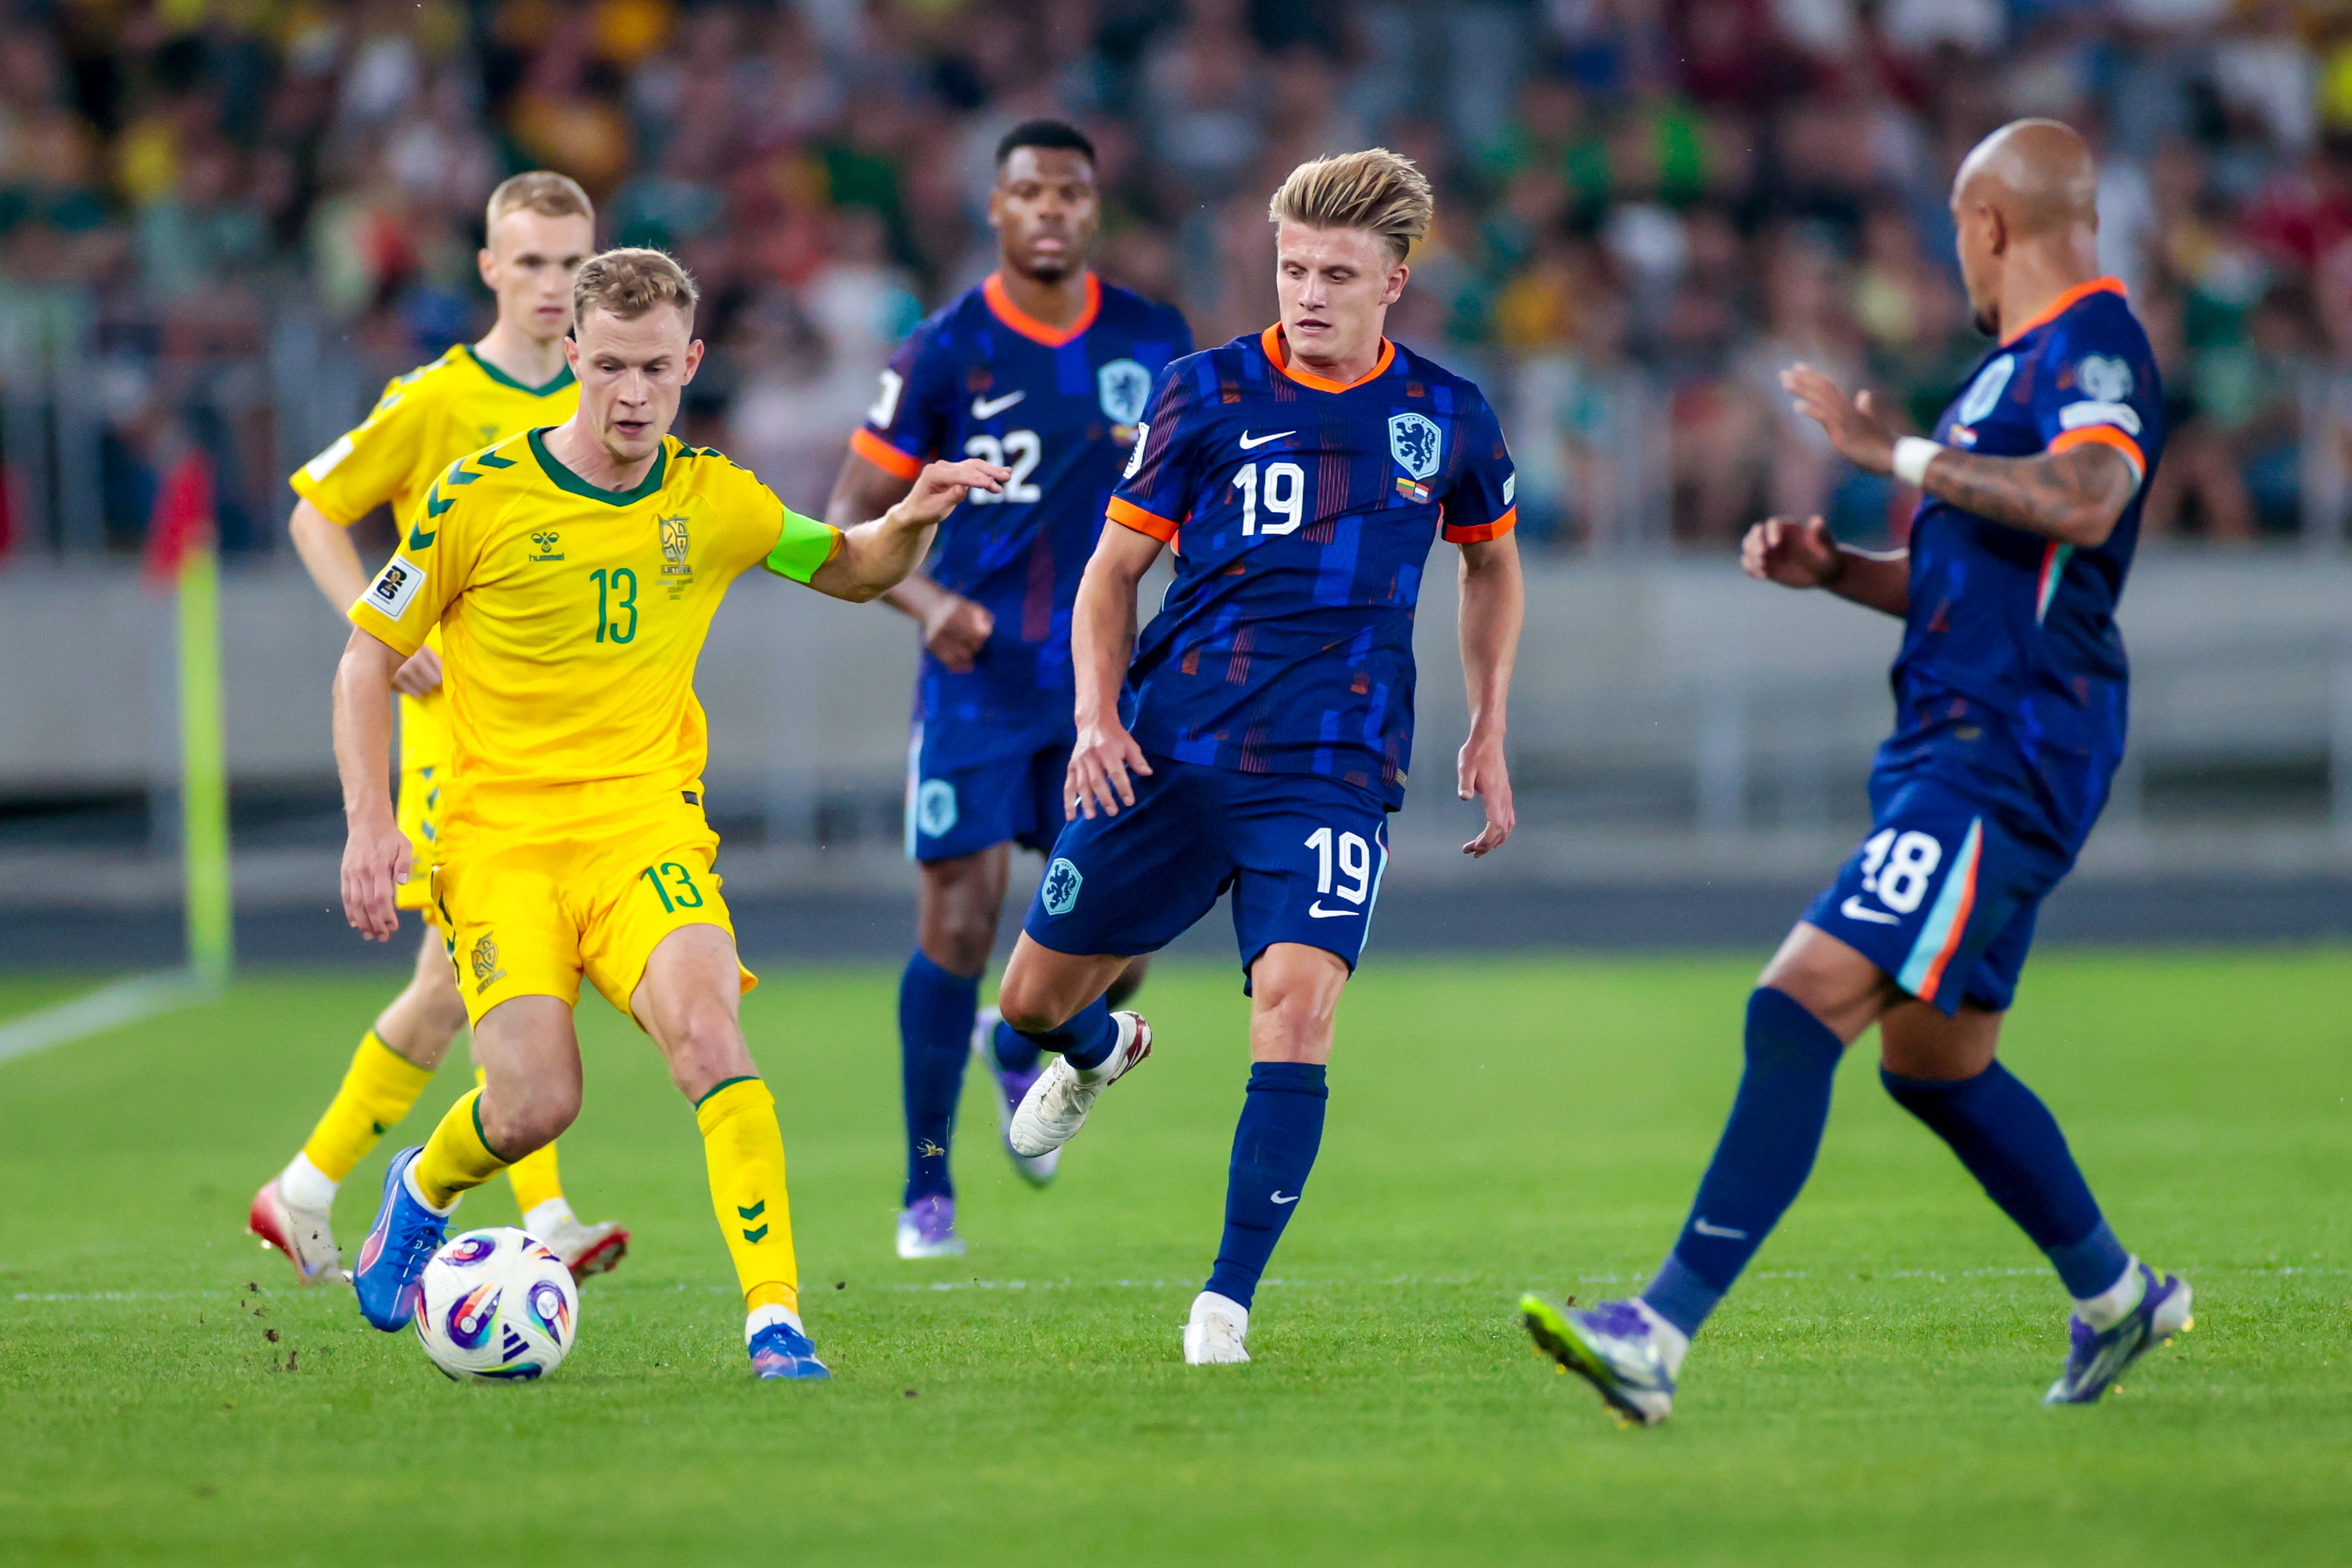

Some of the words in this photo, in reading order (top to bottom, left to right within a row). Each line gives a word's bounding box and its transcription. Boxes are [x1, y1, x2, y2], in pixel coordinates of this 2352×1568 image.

[964, 429, 1042, 505] 22
[1233, 462, 1304, 536] 19
[589, 568, 637, 643] 13
[639, 862, 703, 913] 13
[1304, 827, 1370, 905] 19
[1861, 827, 1942, 913] 18
